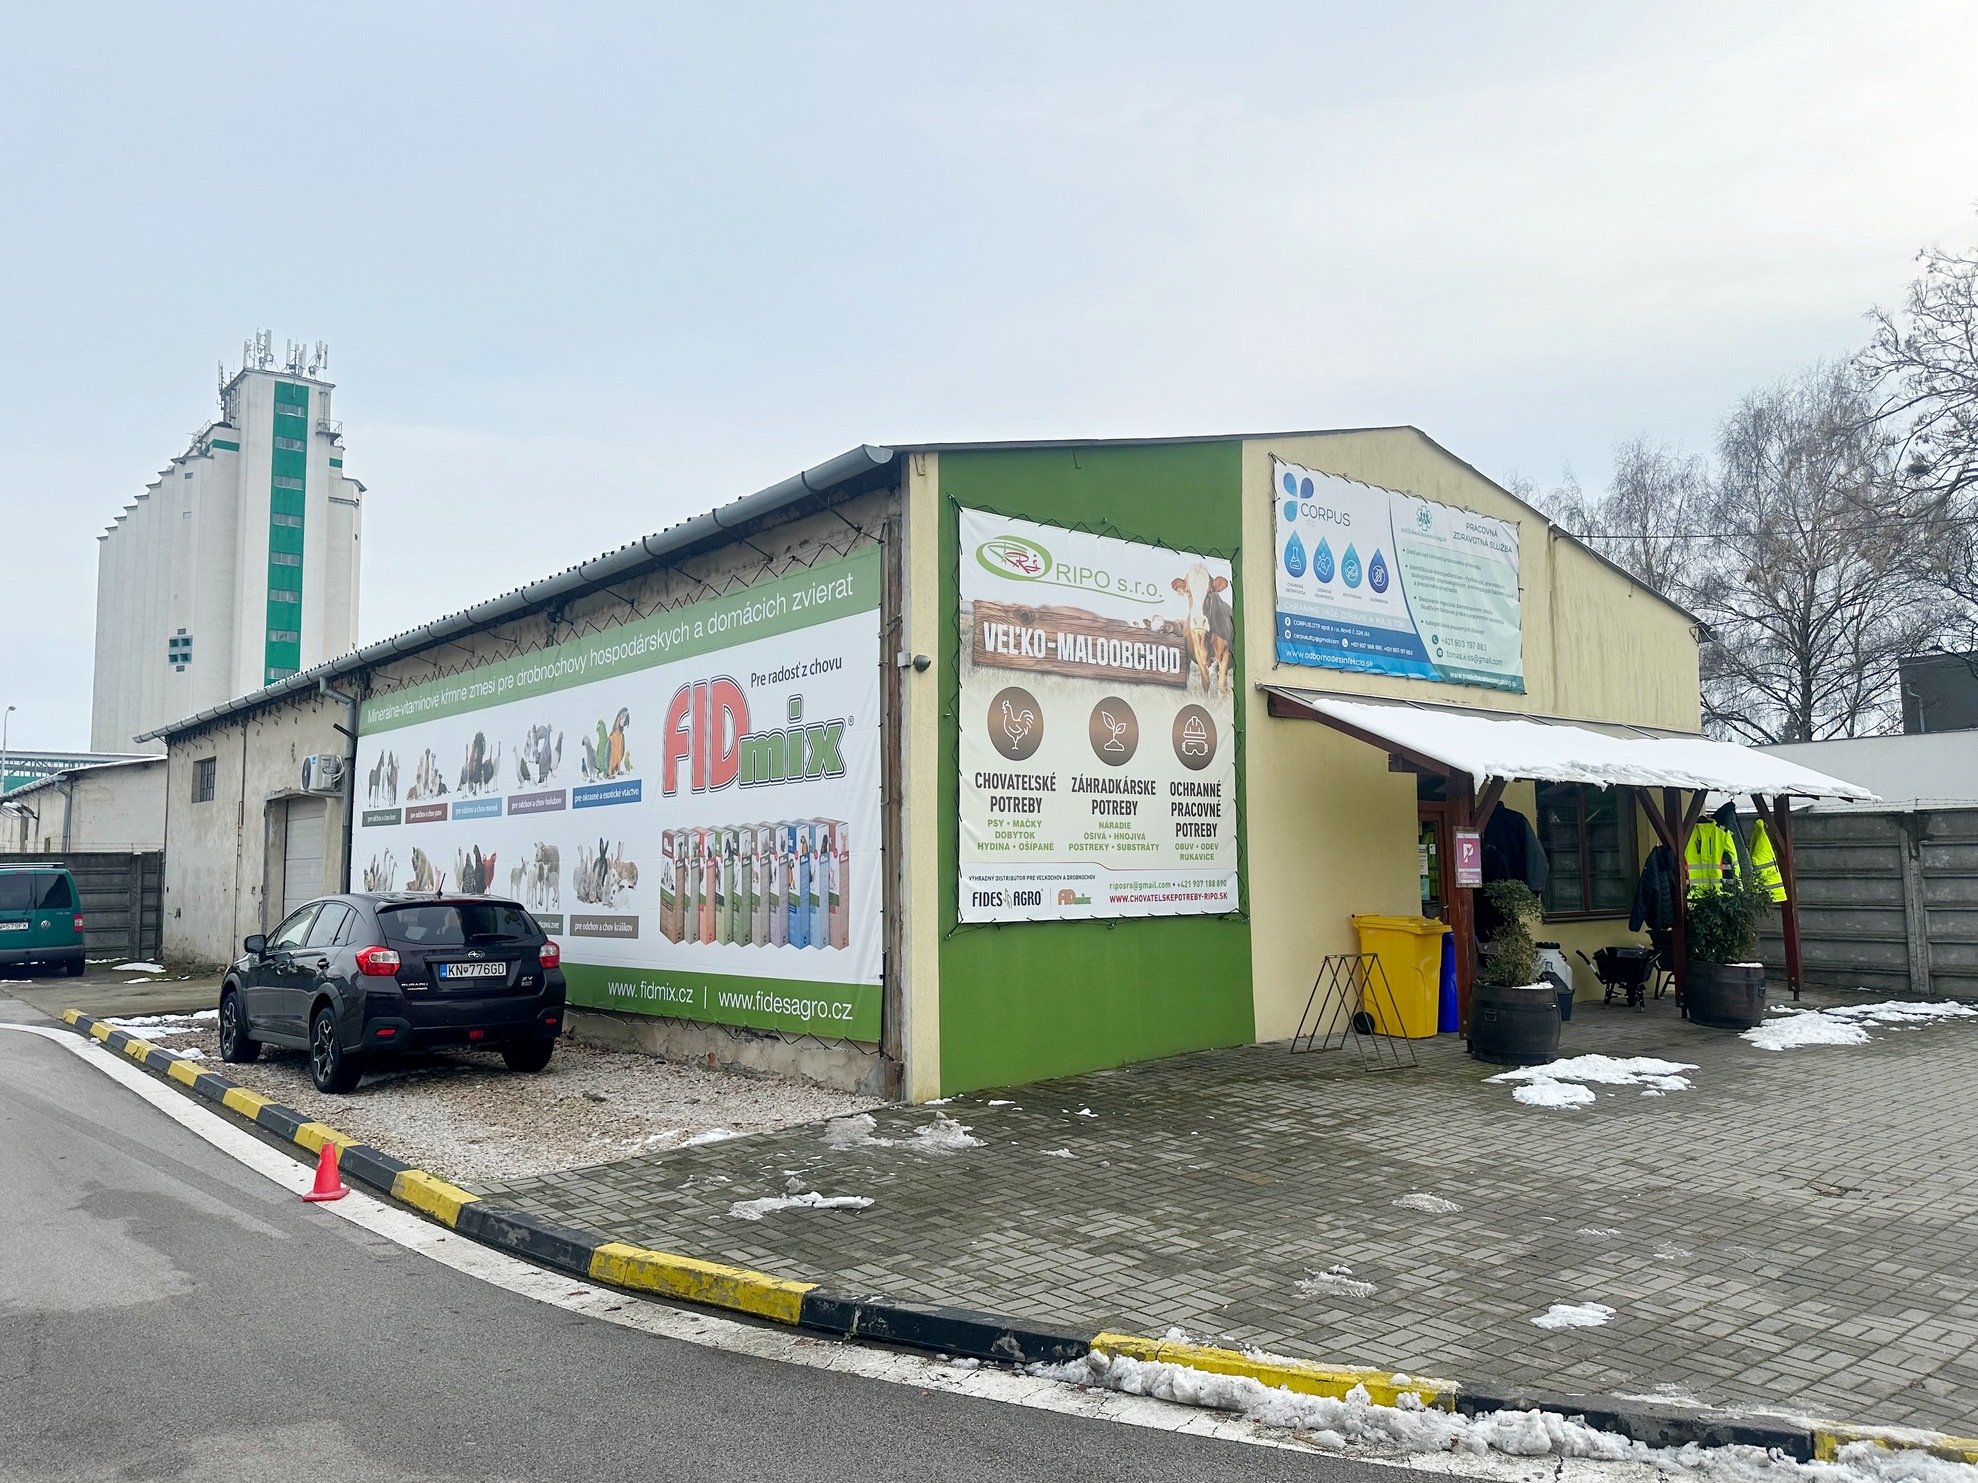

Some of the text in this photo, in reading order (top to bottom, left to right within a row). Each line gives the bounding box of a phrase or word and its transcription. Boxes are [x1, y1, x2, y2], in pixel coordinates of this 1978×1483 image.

[1300, 502, 1351, 527] CORPUS
[1466, 522, 1498, 538] PRACOVNÁ
[1453, 531, 1488, 547] ZDRAVOTNÁ
[1490, 541, 1513, 554] SLUŽBA
[1056, 563, 1164, 598] RIPO s.r.o.
[1321, 607, 1339, 617] VAŠE
[1340, 610, 1368, 623] ZDRAVIE
[367, 572, 854, 723] Minerálne-vitamínové kŕmne zmesi pre drobnochovy hospodárskych a domácich zvierat
[983, 621, 1181, 674] VEĽKO-MALOOBCHOD
[1446, 650, 1503, 666] tomas.kiss@gmail.com
[751, 657, 842, 688] Pre radosť z chovu
[975, 771, 1057, 792] CHOVATEĽSKÉ
[1071, 773, 1156, 796] ZÁHRADKÁRSKE
[1170, 780, 1222, 798] OCHRANNÉ
[575, 795, 583, 804] pre
[990, 795, 1042, 813] POTREBY
[1091, 799, 1138, 816] POTREBY
[1171, 800, 1222, 817] PRACOVNÉ
[987, 818, 1042, 828] PSY MAČKY
[1099, 821, 1131, 829] NÁRADIE
[1175, 822, 1218, 838] POTREBY
[995, 831, 1035, 839] DOBYTOK
[1083, 832, 1146, 840] OSIVÁ HNOJIVÁ
[977, 841, 1054, 851] HYDINA OŠÍPANÉ
[1068, 843, 1160, 851] POSTREKY SUBSTRÁTY
[1179, 853, 1215, 861] RUKAVICE
[1109, 879, 1227, 891] riposro@gmail.com +421 907 188 890
[972, 890, 1041, 907] FIDES AGRO
[1109, 892, 1228, 903] WWW.CHOVATELSKEPOTREBY-RIPO.SK
[574, 923, 582, 932] pre
[582, 921, 599, 931] odchov
[602, 922, 614, 931] chov
[614, 922, 633, 932] králikov
[469, 963, 505, 975] 776GD
[608, 981, 693, 1003] www. fidmix.cz
[718, 990, 853, 1021] www.fidesagro.cz
